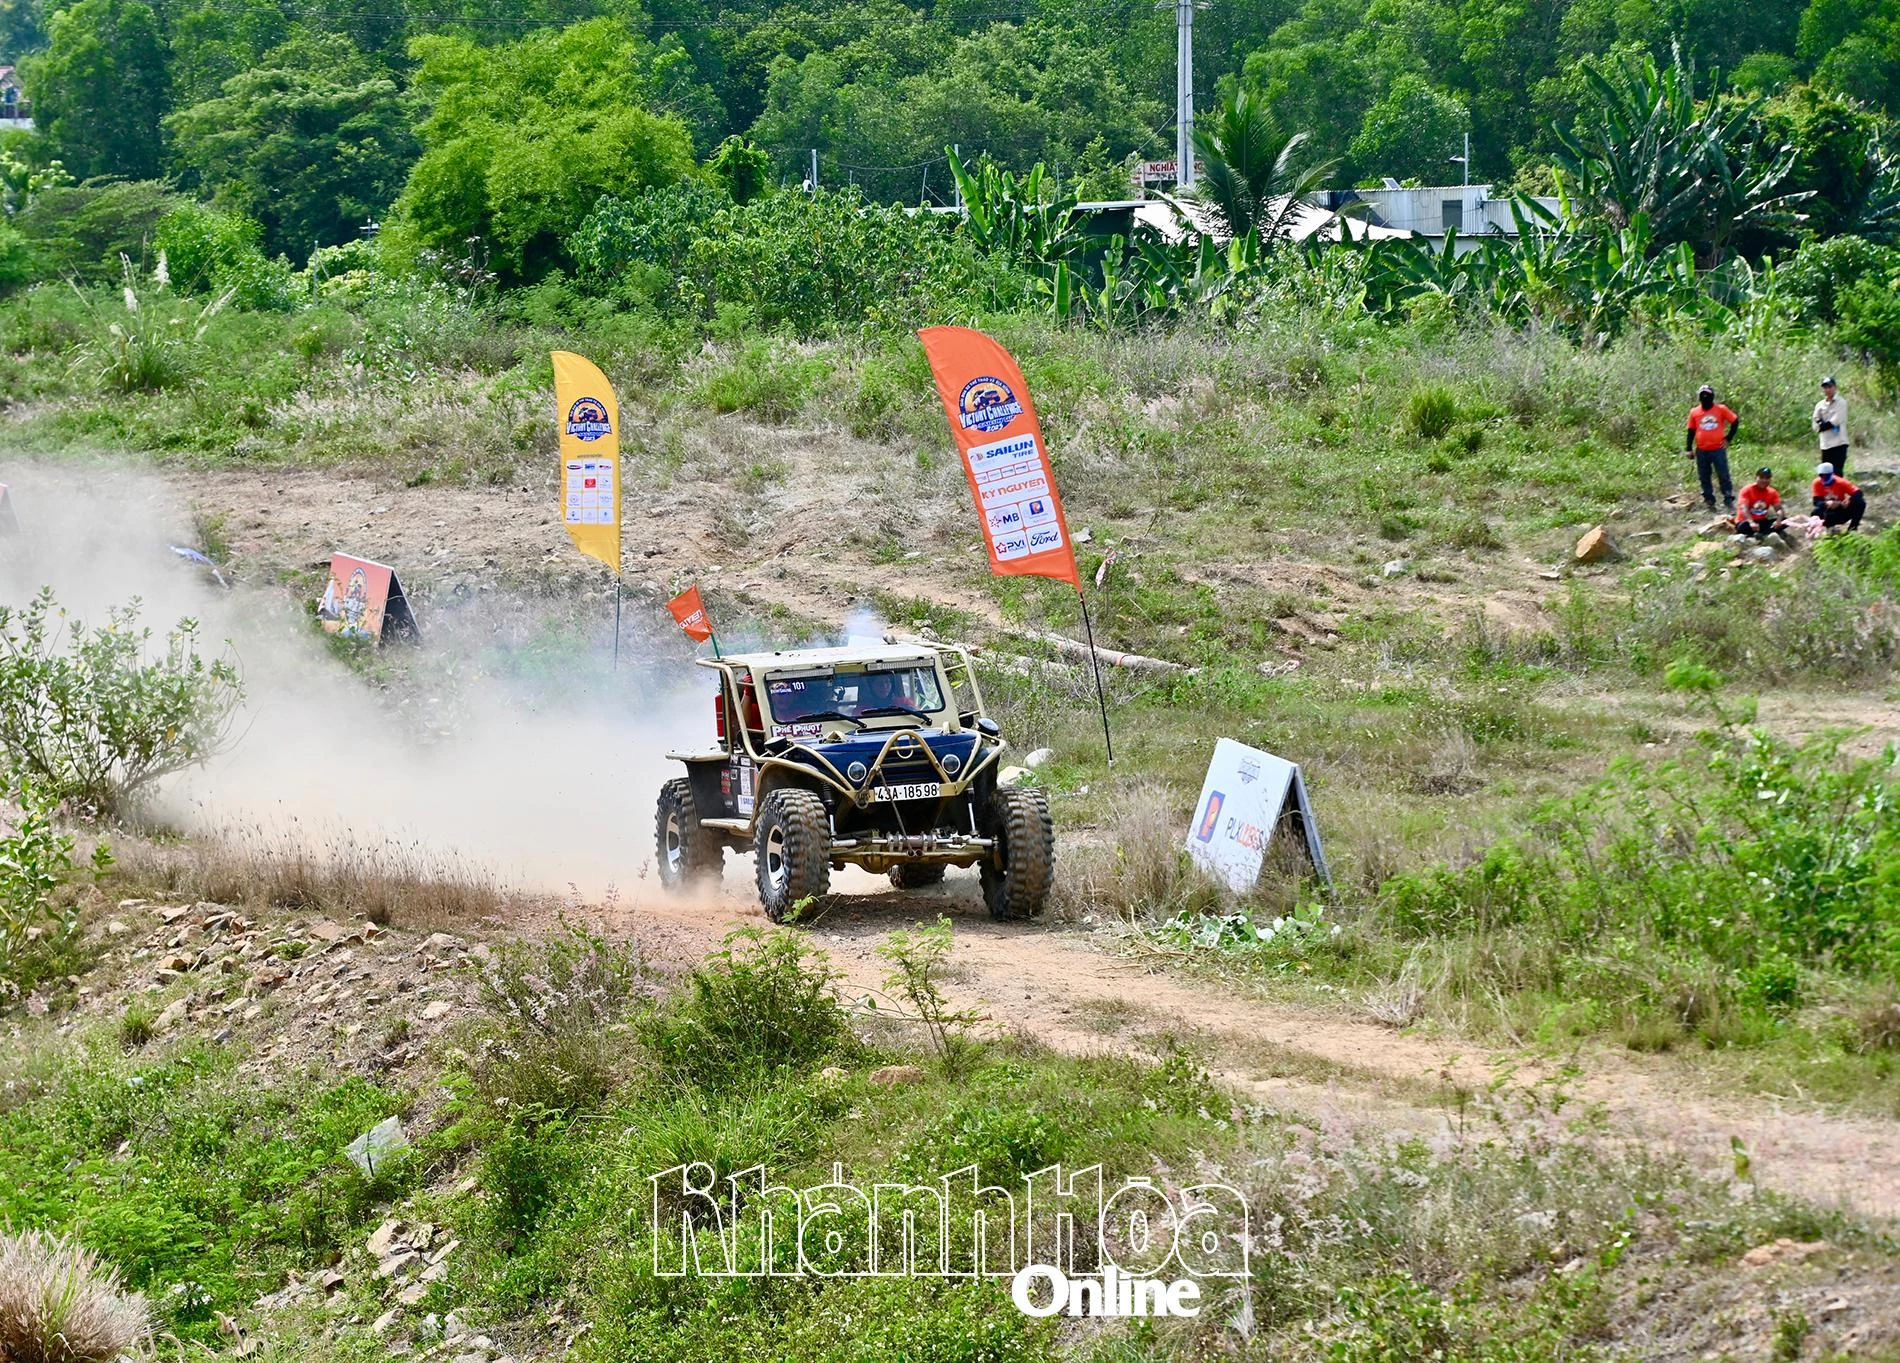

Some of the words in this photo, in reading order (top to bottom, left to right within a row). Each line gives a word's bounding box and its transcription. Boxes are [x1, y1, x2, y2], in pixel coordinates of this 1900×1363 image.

[986, 402, 1022, 421] CHALLENGE
[986, 439, 1033, 459] SAILUN
[1012, 449, 1034, 459] TIRE
[1002, 512, 1020, 524] MB
[1006, 539, 1025, 549] PVI
[1030, 530, 1059, 547] Ford
[792, 681, 805, 690] 101
